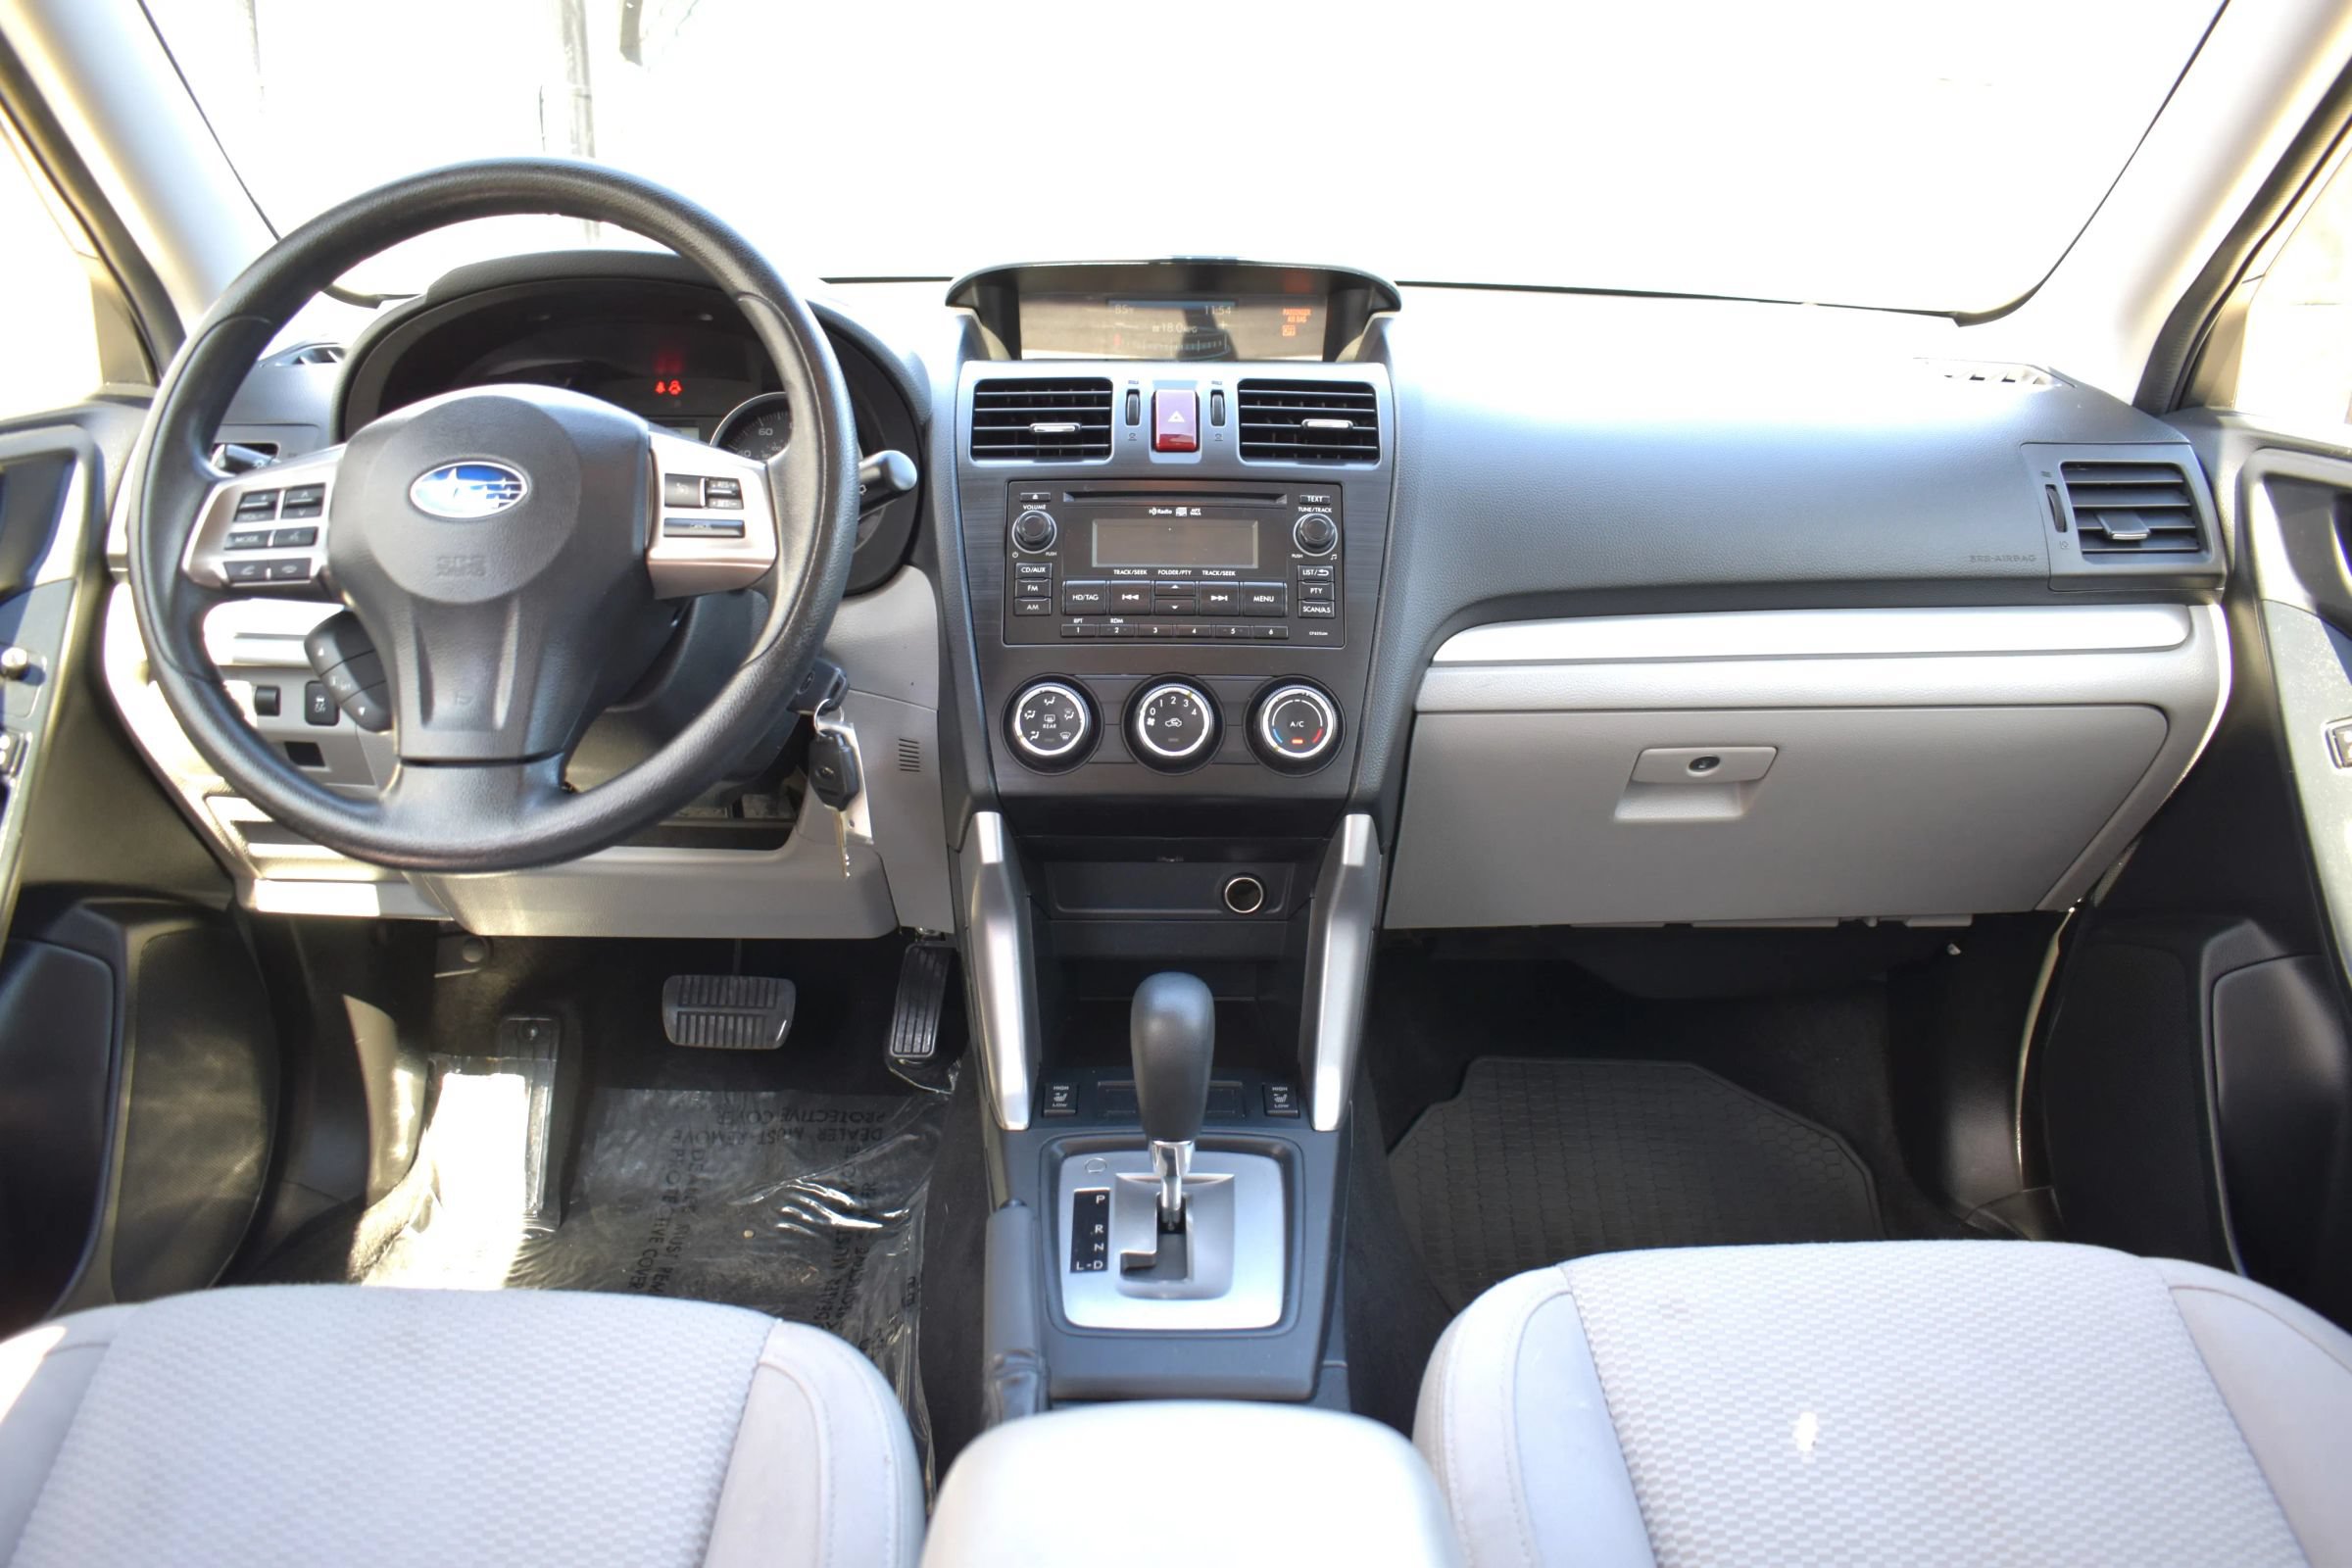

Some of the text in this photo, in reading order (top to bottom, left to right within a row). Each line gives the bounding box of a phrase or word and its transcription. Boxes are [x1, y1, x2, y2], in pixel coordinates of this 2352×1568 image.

[1204, 305, 1232, 315] 11:54
[758, 427, 773, 436] 60
[1159, 699, 1163, 709] 1
[1170, 696, 1177, 705] 2
[1183, 699, 1190, 709] 3
[1150, 707, 1156, 717] 0
[1191, 708, 1198, 717] 4
[1096, 1195, 1105, 1204] P
[1095, 1224, 1103, 1234] R
[1094, 1243, 1104, 1251] N
[627, 1248, 659, 1291] COVER
